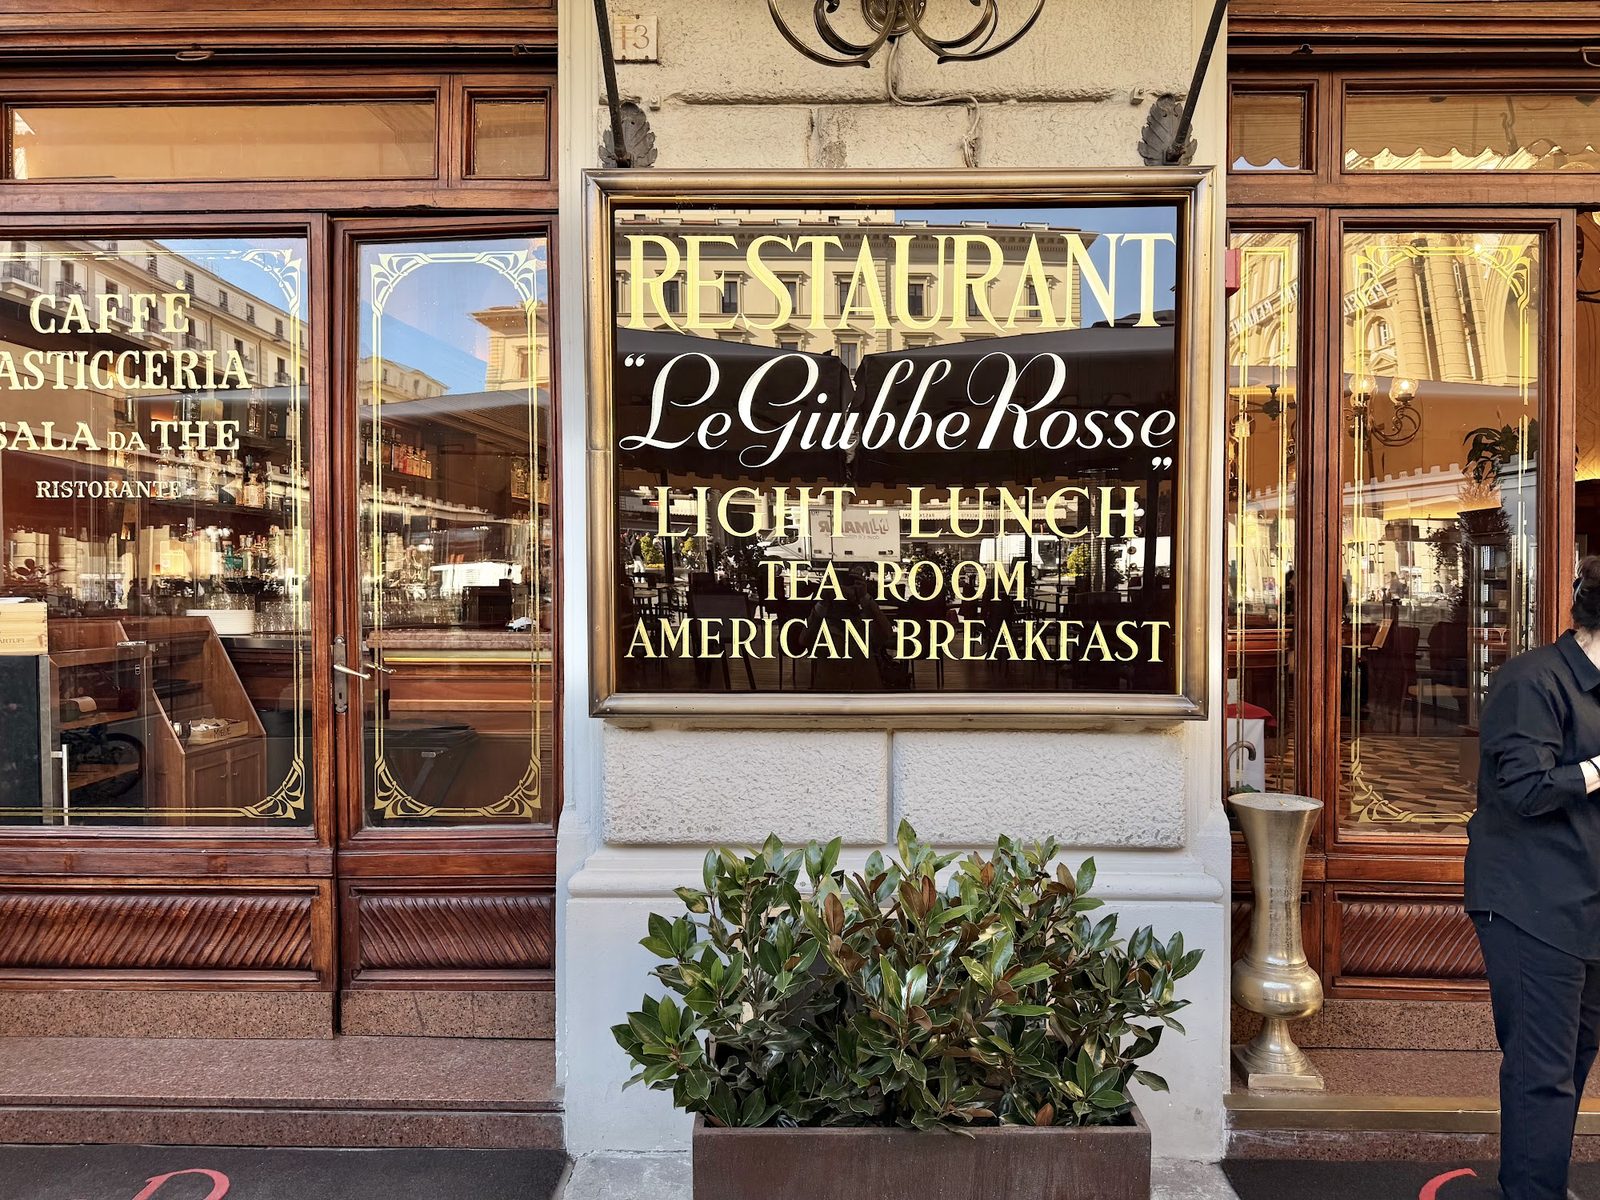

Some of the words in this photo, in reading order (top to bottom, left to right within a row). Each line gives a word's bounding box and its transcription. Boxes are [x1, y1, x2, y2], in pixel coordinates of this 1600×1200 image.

[621, 24, 650, 50] 13
[624, 233, 1176, 333] RESTAURANT
[737, 353, 969, 468] Giubbe
[107, 431, 147, 451] DA
[151, 420, 240, 451] THE
[35, 480, 182, 499] RISTORANTE
[654, 486, 856, 539] LIGHT
[905, 486, 1142, 539] LUNCH
[757, 560, 845, 601] TEA
[877, 560, 1026, 602] ROOM
[624, 617, 872, 660] AMERICAN
[896, 618, 1170, 664] BREAKFAST
